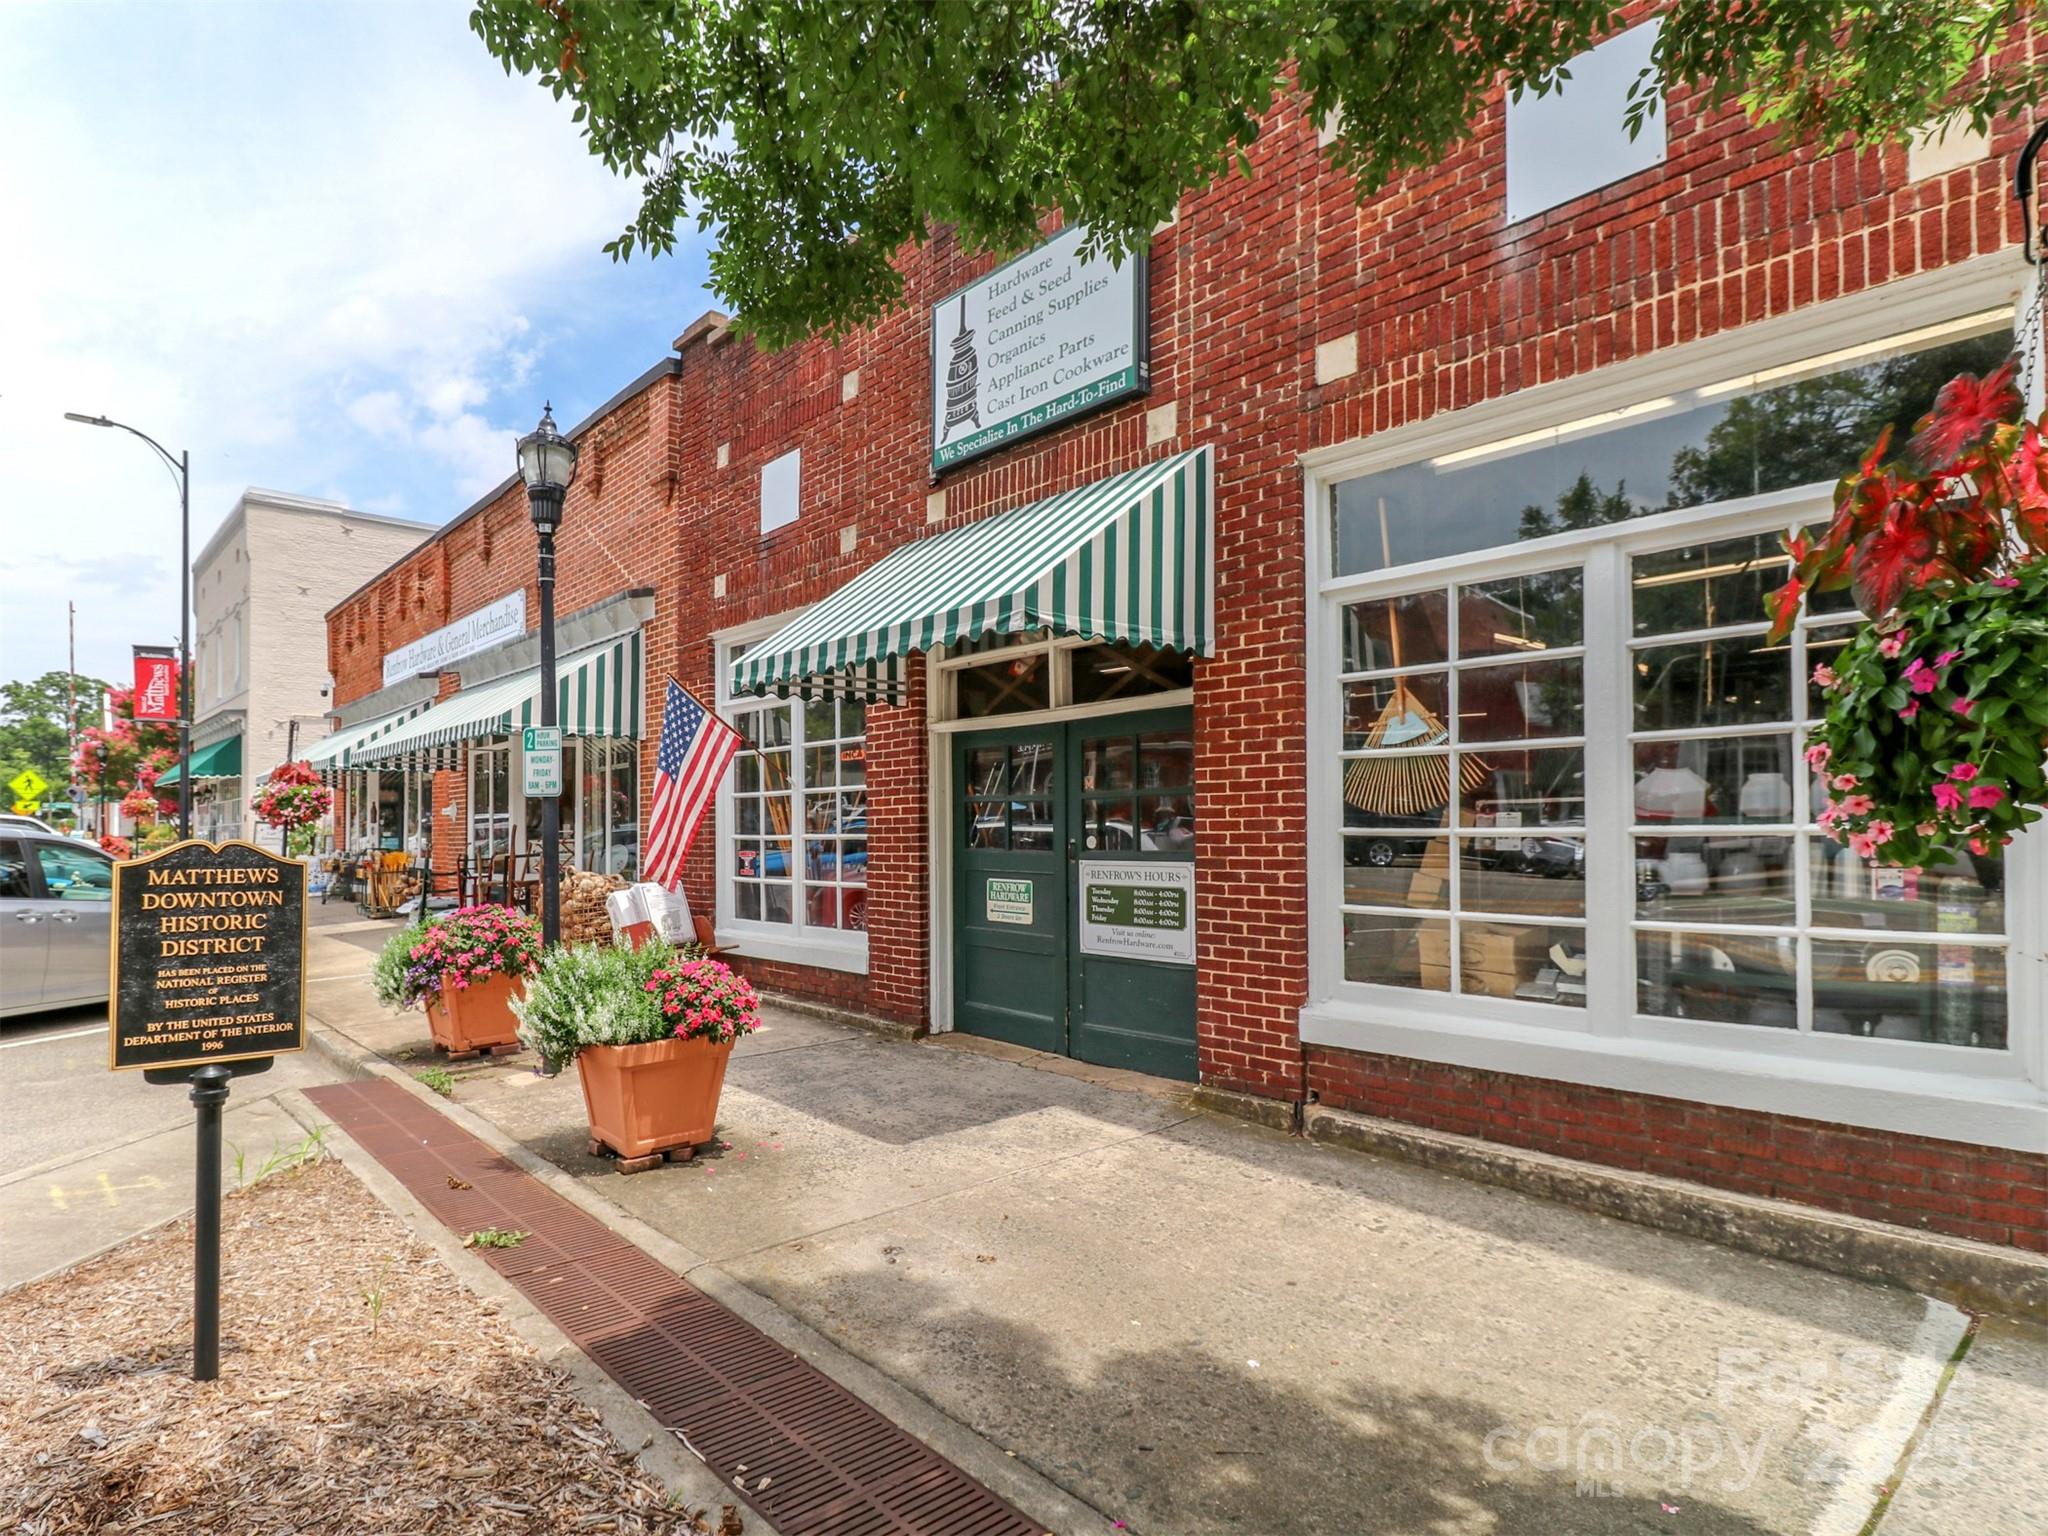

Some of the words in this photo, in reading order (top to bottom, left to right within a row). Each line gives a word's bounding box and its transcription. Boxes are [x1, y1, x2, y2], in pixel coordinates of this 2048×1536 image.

[988, 256, 1053, 300] Hardware
[988, 296, 1017, 324] Feed
[1021, 289, 1034, 305] &
[1039, 266, 1072, 297] Seed
[988, 310, 1044, 346] Canning
[1048, 276, 1109, 316] Supplies
[987, 333, 1046, 369] Organics
[987, 354, 1054, 393] Appliance
[1058, 334, 1095, 360] Parts
[987, 395, 1015, 415] Cast
[1020, 381, 1048, 402] Iron
[1053, 342, 1129, 386] Cookware
[940, 447, 955, 463] We
[956, 427, 1004, 457] Specialize
[1007, 421, 1018, 436] In
[1021, 411, 1043, 430] The
[1046, 372, 1127, 420] Hard-To-Find
[445, 620, 471, 654] General
[471, 603, 518, 641] Merchandise
[146, 663, 165, 714] Matthews
[527, 732, 534, 749] 2
[147, 868, 279, 885] MATTHEWS
[1144, 871, 1181, 882] HOURS
[990, 891, 1030, 902] HARDWARE
[992, 882, 1026, 892] RENFROW
[141, 890, 284, 910] DOWNTOWN
[1091, 896, 1119, 906] Wednesday
[1091, 905, 1115, 914] Thursday
[160, 913, 268, 933] HISTORIC
[1091, 914, 1107, 923] Friday
[160, 936, 266, 957] DISTRICT
[1096, 936, 1174, 950] RenfrowHardware.com
[158, 969, 177, 977] HAS
[178, 967, 201, 976] BEEN
[203, 966, 234, 975] PLACED
[250, 963, 267, 972] THE
[156, 977, 213, 989] NATIONAL
[217, 973, 268, 985] REGISTER
[165, 999, 216, 1009] HISTORIC
[219, 993, 259, 1004] PLACES
[147, 1022, 163, 1032] BY
[166, 1020, 190, 1030] THE
[192, 1016, 234, 1028] UNITED
[235, 1012, 275, 1023] STATES
[124, 1031, 201, 1047] DEPARTMENT
[203, 1029, 218, 1039] OF
[220, 1026, 242, 1037] THE
[244, 1022, 294, 1035] INTERIOR
[201, 1041, 224, 1050] 1996
